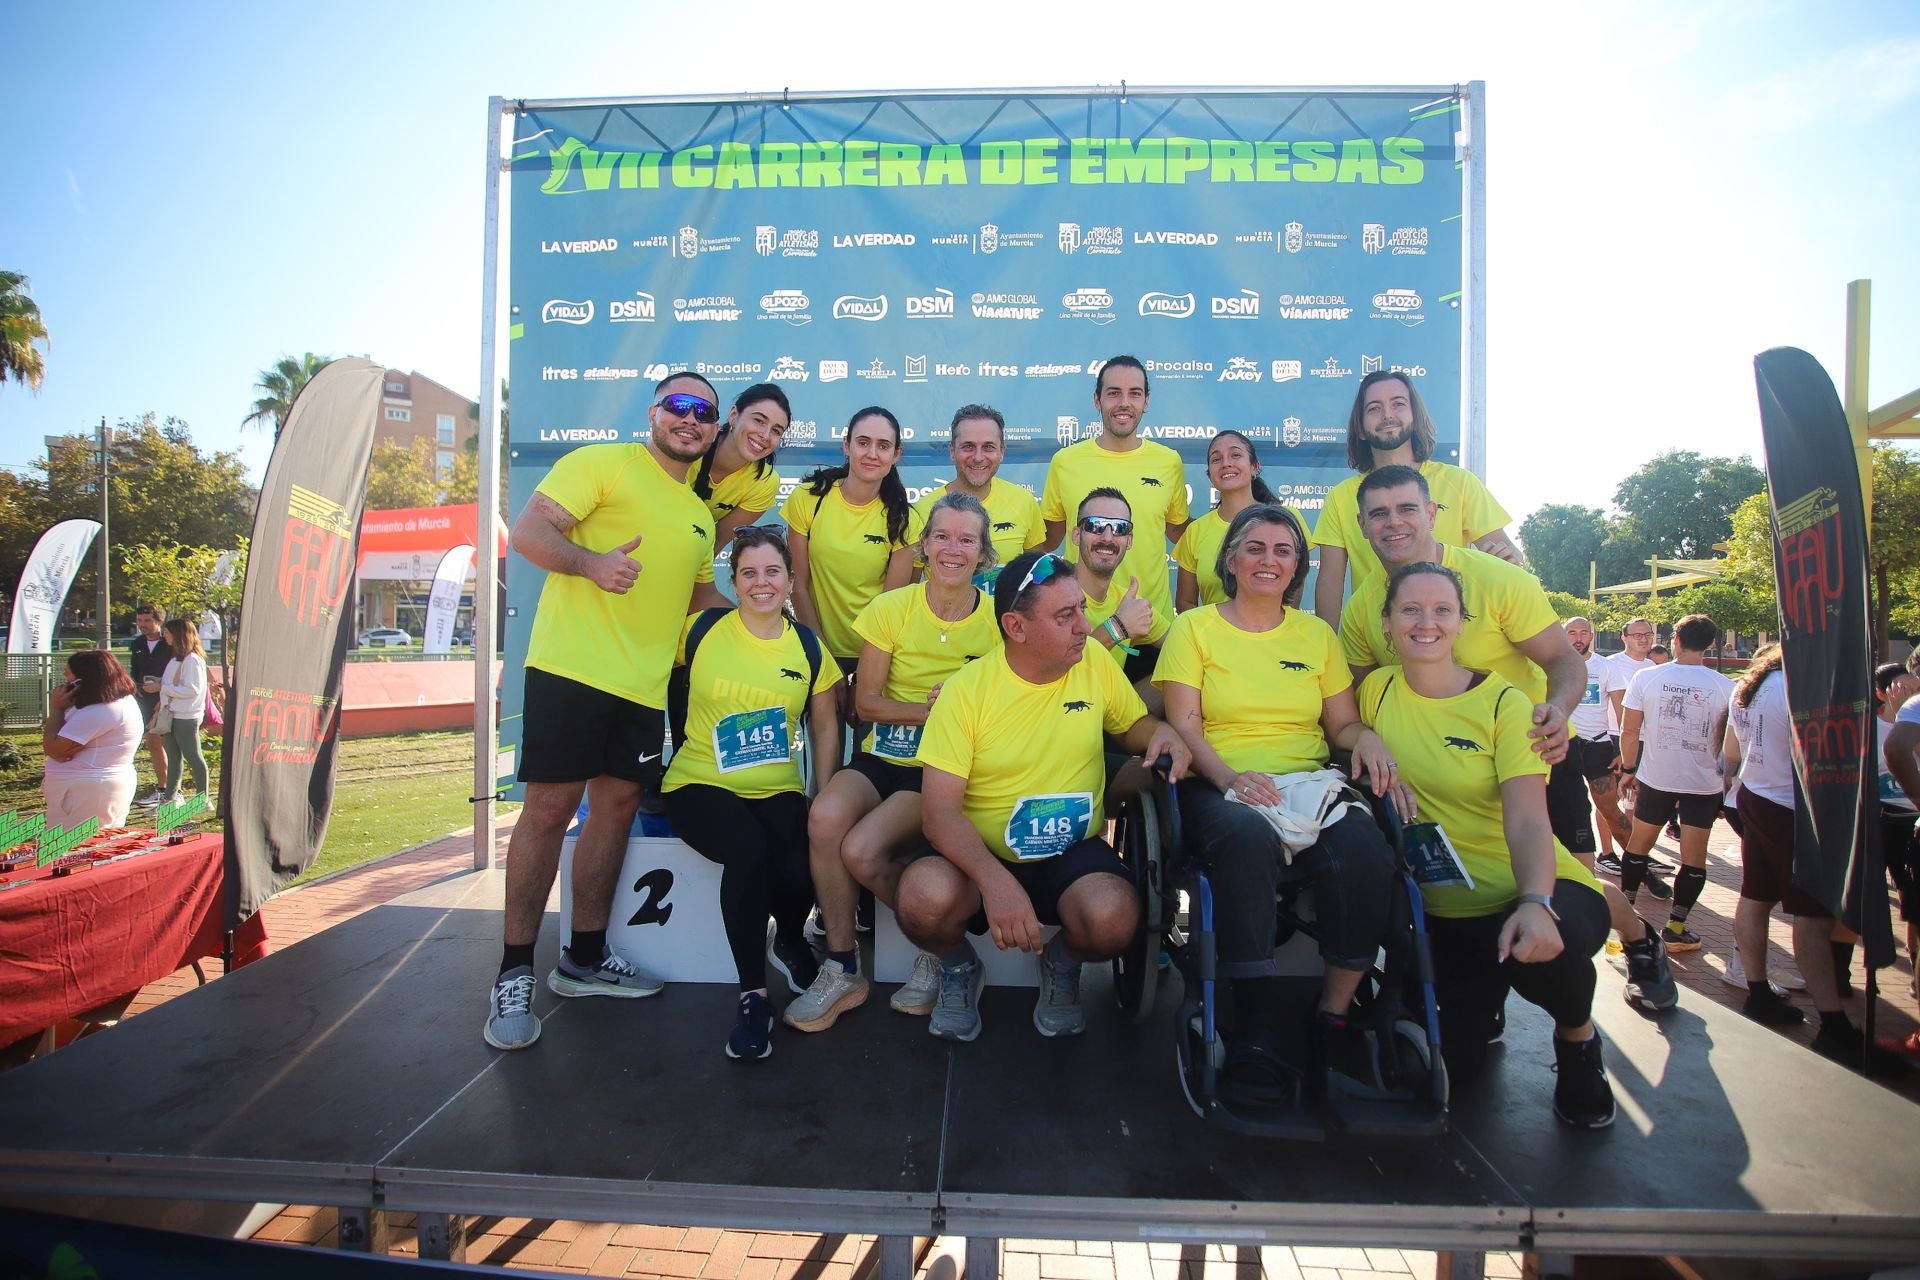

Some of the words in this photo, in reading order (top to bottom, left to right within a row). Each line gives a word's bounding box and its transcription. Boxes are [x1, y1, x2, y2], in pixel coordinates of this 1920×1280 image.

[672, 140, 968, 189] CARRERA
[980, 138, 1058, 185] DE
[1070, 137, 1425, 184] EMPRESAS
[779, 240, 819, 248] ATLETISMO
[854, 233, 916, 247] VERDAD
[1009, 239, 1034, 247] Murcia
[1082, 237, 1124, 246] ATLETISMO
[1156, 231, 1219, 246] VERDAD
[1314, 240, 1338, 248] Murcia
[1386, 238, 1428, 247] ATLETISMO
[562, 238, 618, 253] VERDAD
[709, 244, 731, 252] Murcia
[688, 297, 706, 308] AMC
[707, 296, 736, 306] GLOBAL
[906, 296, 954, 314] DSM
[986, 294, 1006, 304] AMC
[1007, 295, 1038, 304] GLOBAL
[1147, 299, 1188, 311] VIDAL
[1295, 295, 1315, 305] AMC
[1316, 296, 1347, 305] GLOBAL
[550, 306, 587, 318] VIDAL
[609, 300, 655, 318] DSM
[840, 302, 881, 314] VIDAL
[1211, 297, 1259, 315] DSM
[583, 366, 639, 379] atalayas
[696, 362, 761, 374] Brocalsa
[935, 363, 972, 376] Hero
[1024, 363, 1082, 376] atalayas
[1145, 360, 1213, 372] Brocalsa
[1310, 368, 1353, 376] ESTRELLA
[560, 428, 619, 441] VERDAD
[1154, 426, 1218, 439] VERDAD
[905, 486, 932, 504] DS
[1315, 485, 1333, 495] GLO
[361, 520, 404, 534] ntamiento
[405, 517, 417, 532] de
[418, 516, 451, 530] Murcia
[1662, 684, 1692, 697] bionet
[736, 725, 775, 747] 145
[1029, 816, 1072, 836] 148
[627, 868, 674, 927] 2
